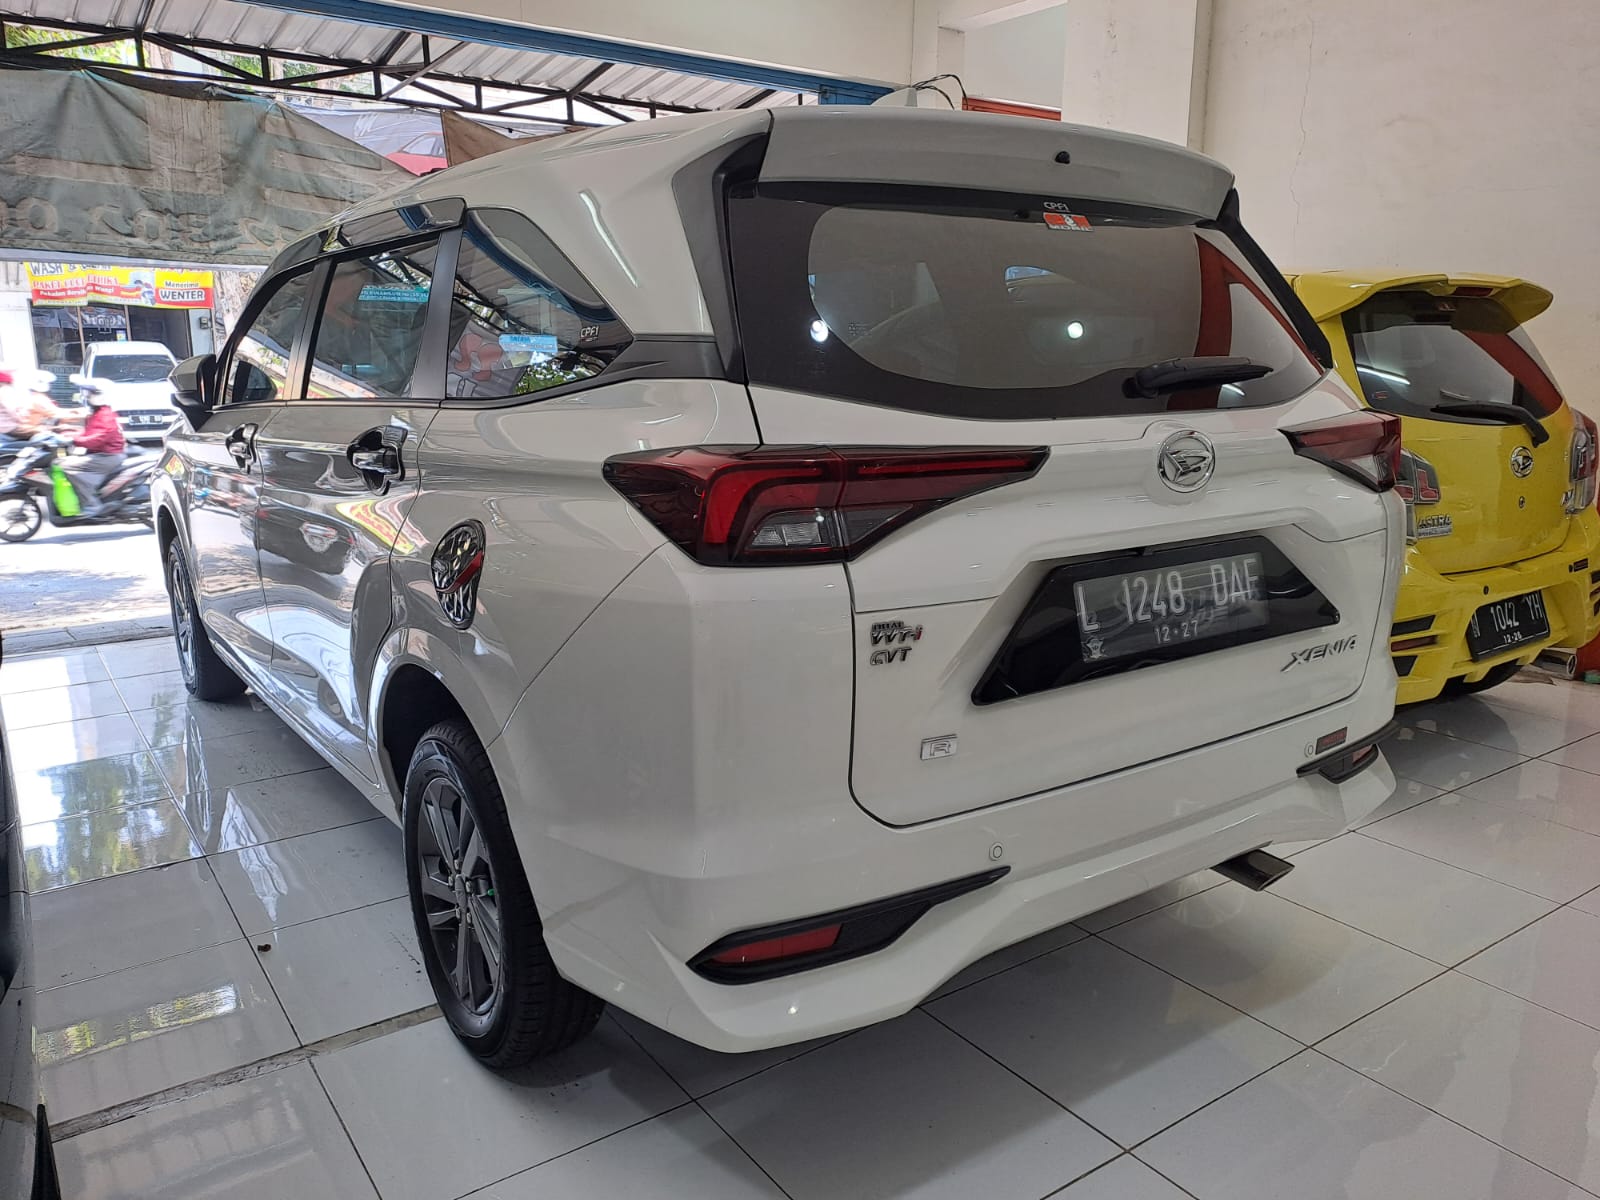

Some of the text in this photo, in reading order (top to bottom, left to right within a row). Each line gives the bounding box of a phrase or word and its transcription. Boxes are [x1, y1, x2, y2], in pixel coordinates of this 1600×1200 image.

[31, 262, 63, 275] WASH
[161, 289, 204, 300] WENTER
[1417, 514, 1453, 529] ASTRA
[1077, 558, 1258, 632] L 1248 DAF
[1490, 602, 1520, 632] 1042
[870, 647, 913, 666] CVT
[1280, 634, 1358, 672] XENIA
